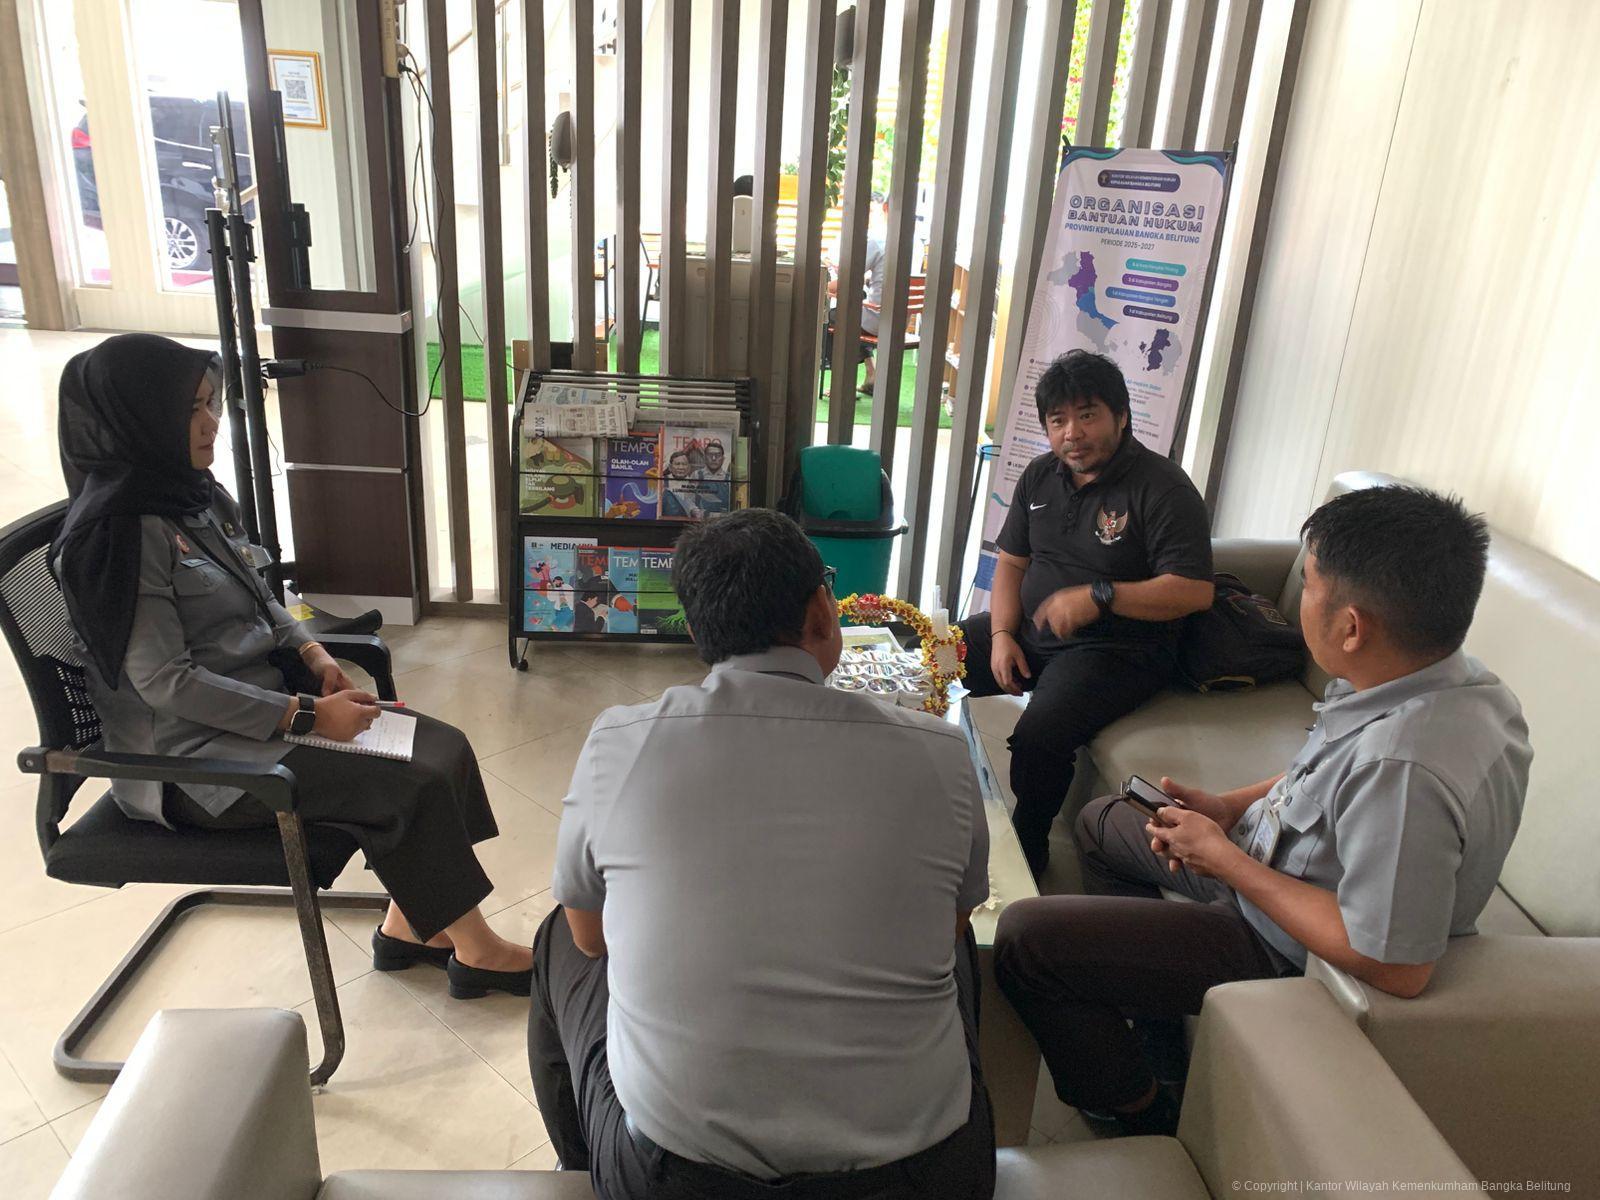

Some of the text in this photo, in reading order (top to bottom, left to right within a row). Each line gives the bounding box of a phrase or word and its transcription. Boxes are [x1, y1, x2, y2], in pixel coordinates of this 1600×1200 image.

[1069, 194, 1205, 220] ORGANISASI
[1068, 210, 1202, 232] BANTUAN HUKUM
[1064, 222, 1200, 244] PROVINSI KEPULAUAN BANGKA BELITUNG
[1100, 238, 1123, 247] PERIODE
[613, 440, 656, 454] TEMPO
[550, 542, 576, 550] MEDIA
